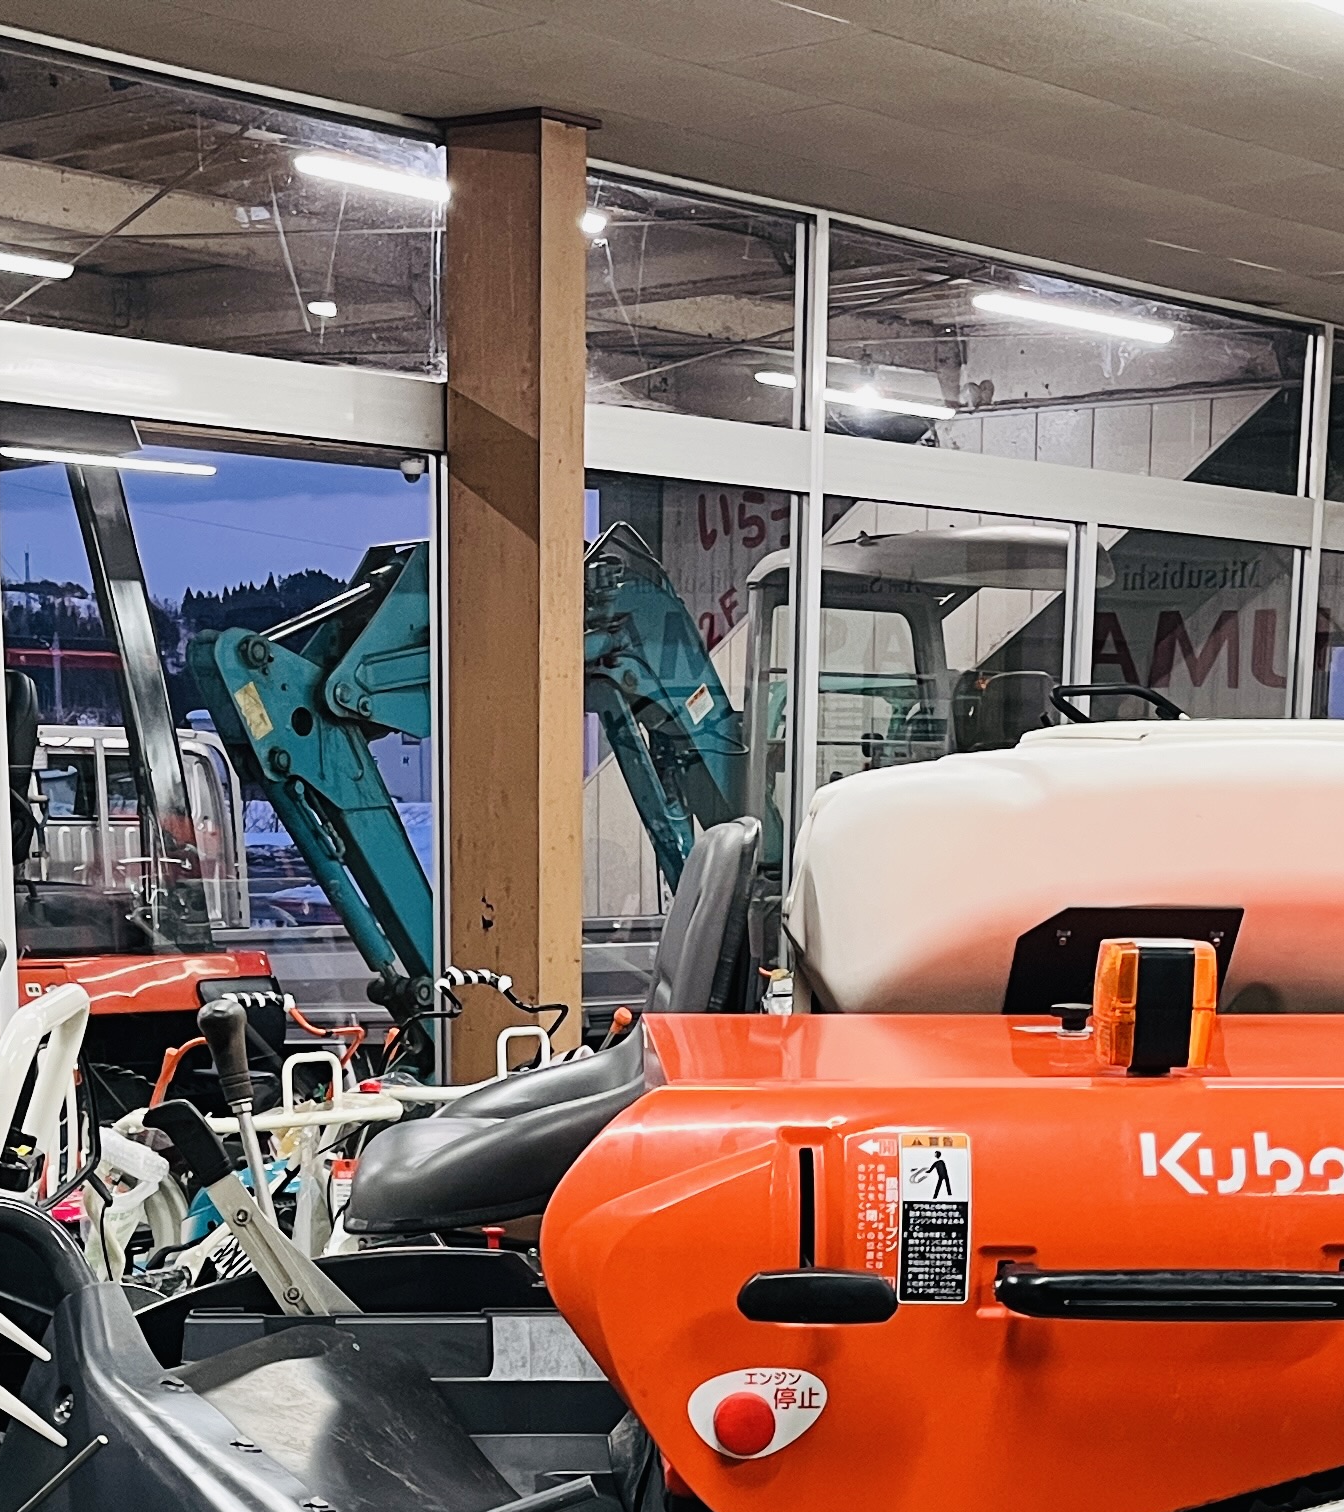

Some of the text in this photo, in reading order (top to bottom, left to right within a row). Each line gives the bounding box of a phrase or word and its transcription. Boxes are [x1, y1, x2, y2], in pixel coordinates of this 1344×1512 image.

[744, 1371, 802, 1386] エンジン
[773, 1387, 821, 1410] 停止
